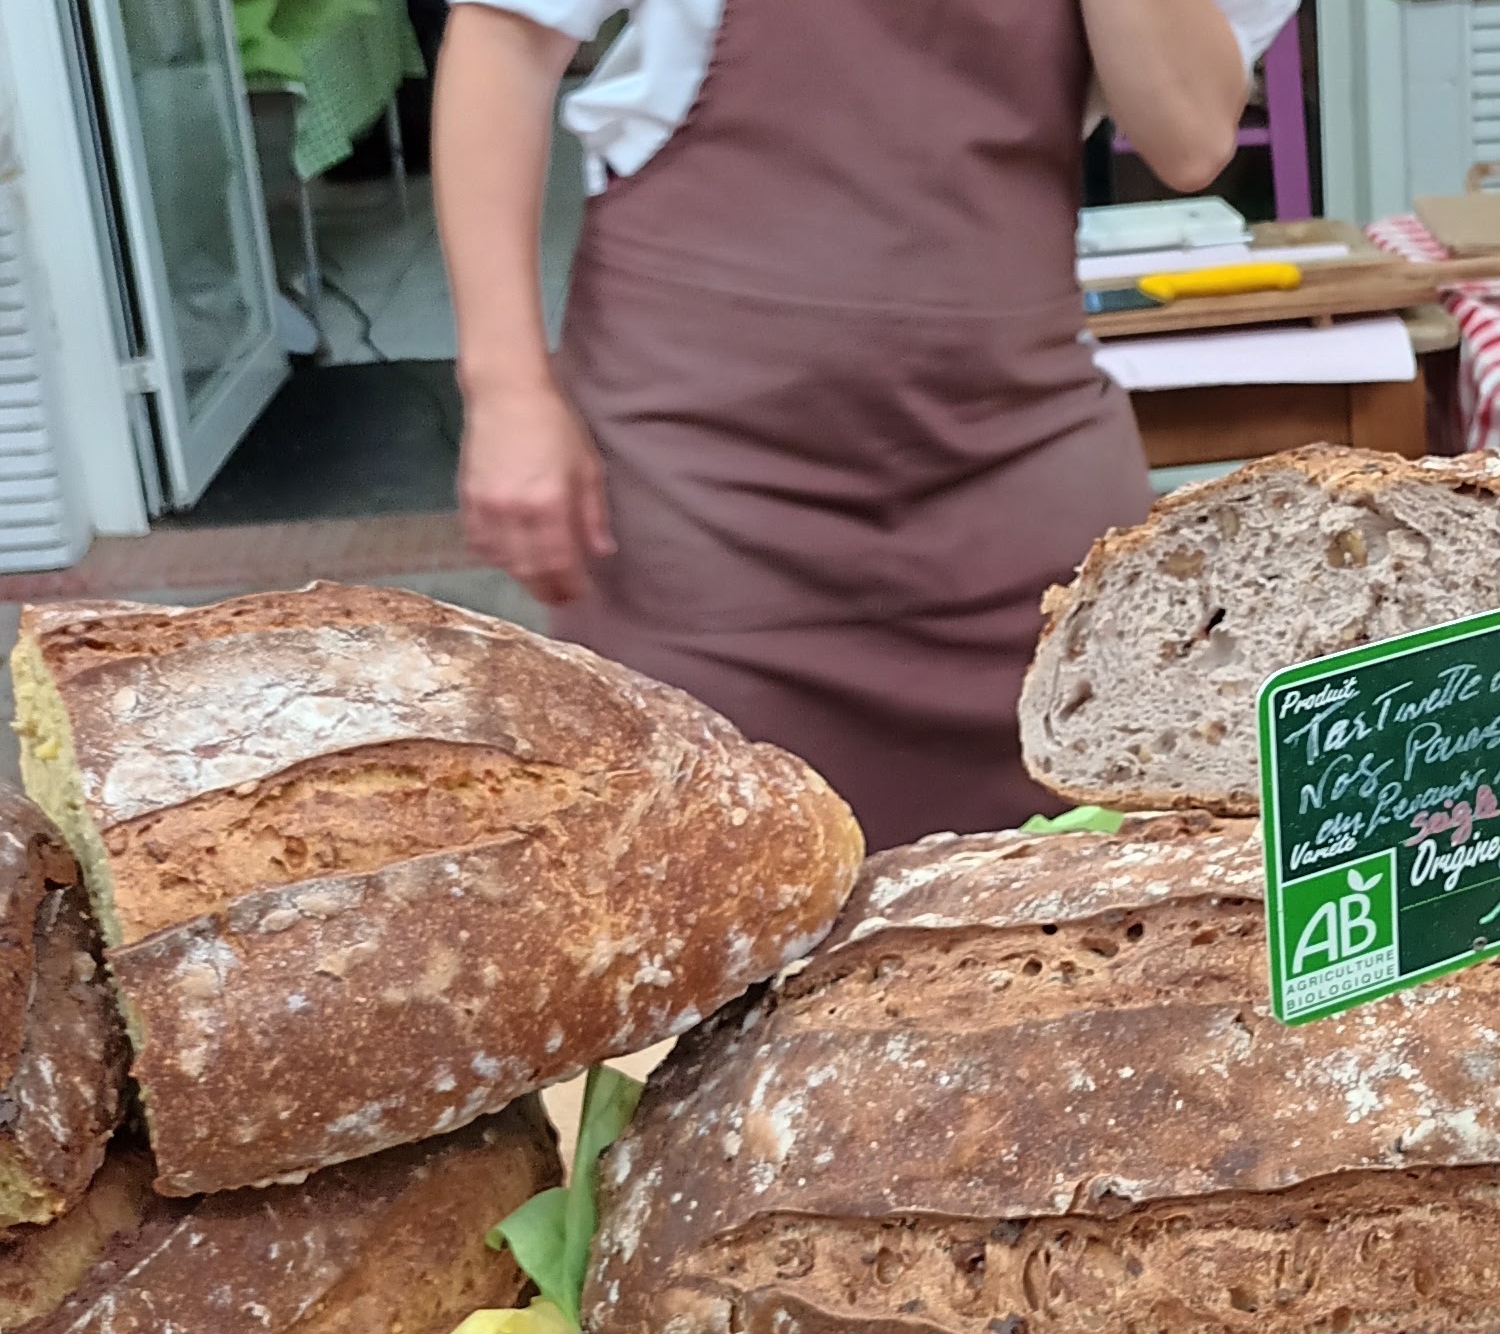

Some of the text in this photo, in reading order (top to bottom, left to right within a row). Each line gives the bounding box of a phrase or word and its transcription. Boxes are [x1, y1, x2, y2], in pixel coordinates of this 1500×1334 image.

[1279, 677, 1360, 718] Produit
[1292, 893, 1377, 975] AB
[1286, 949, 1395, 995] AGRICULTURE
[1287, 964, 1395, 1010] BIOLOGIQUE
